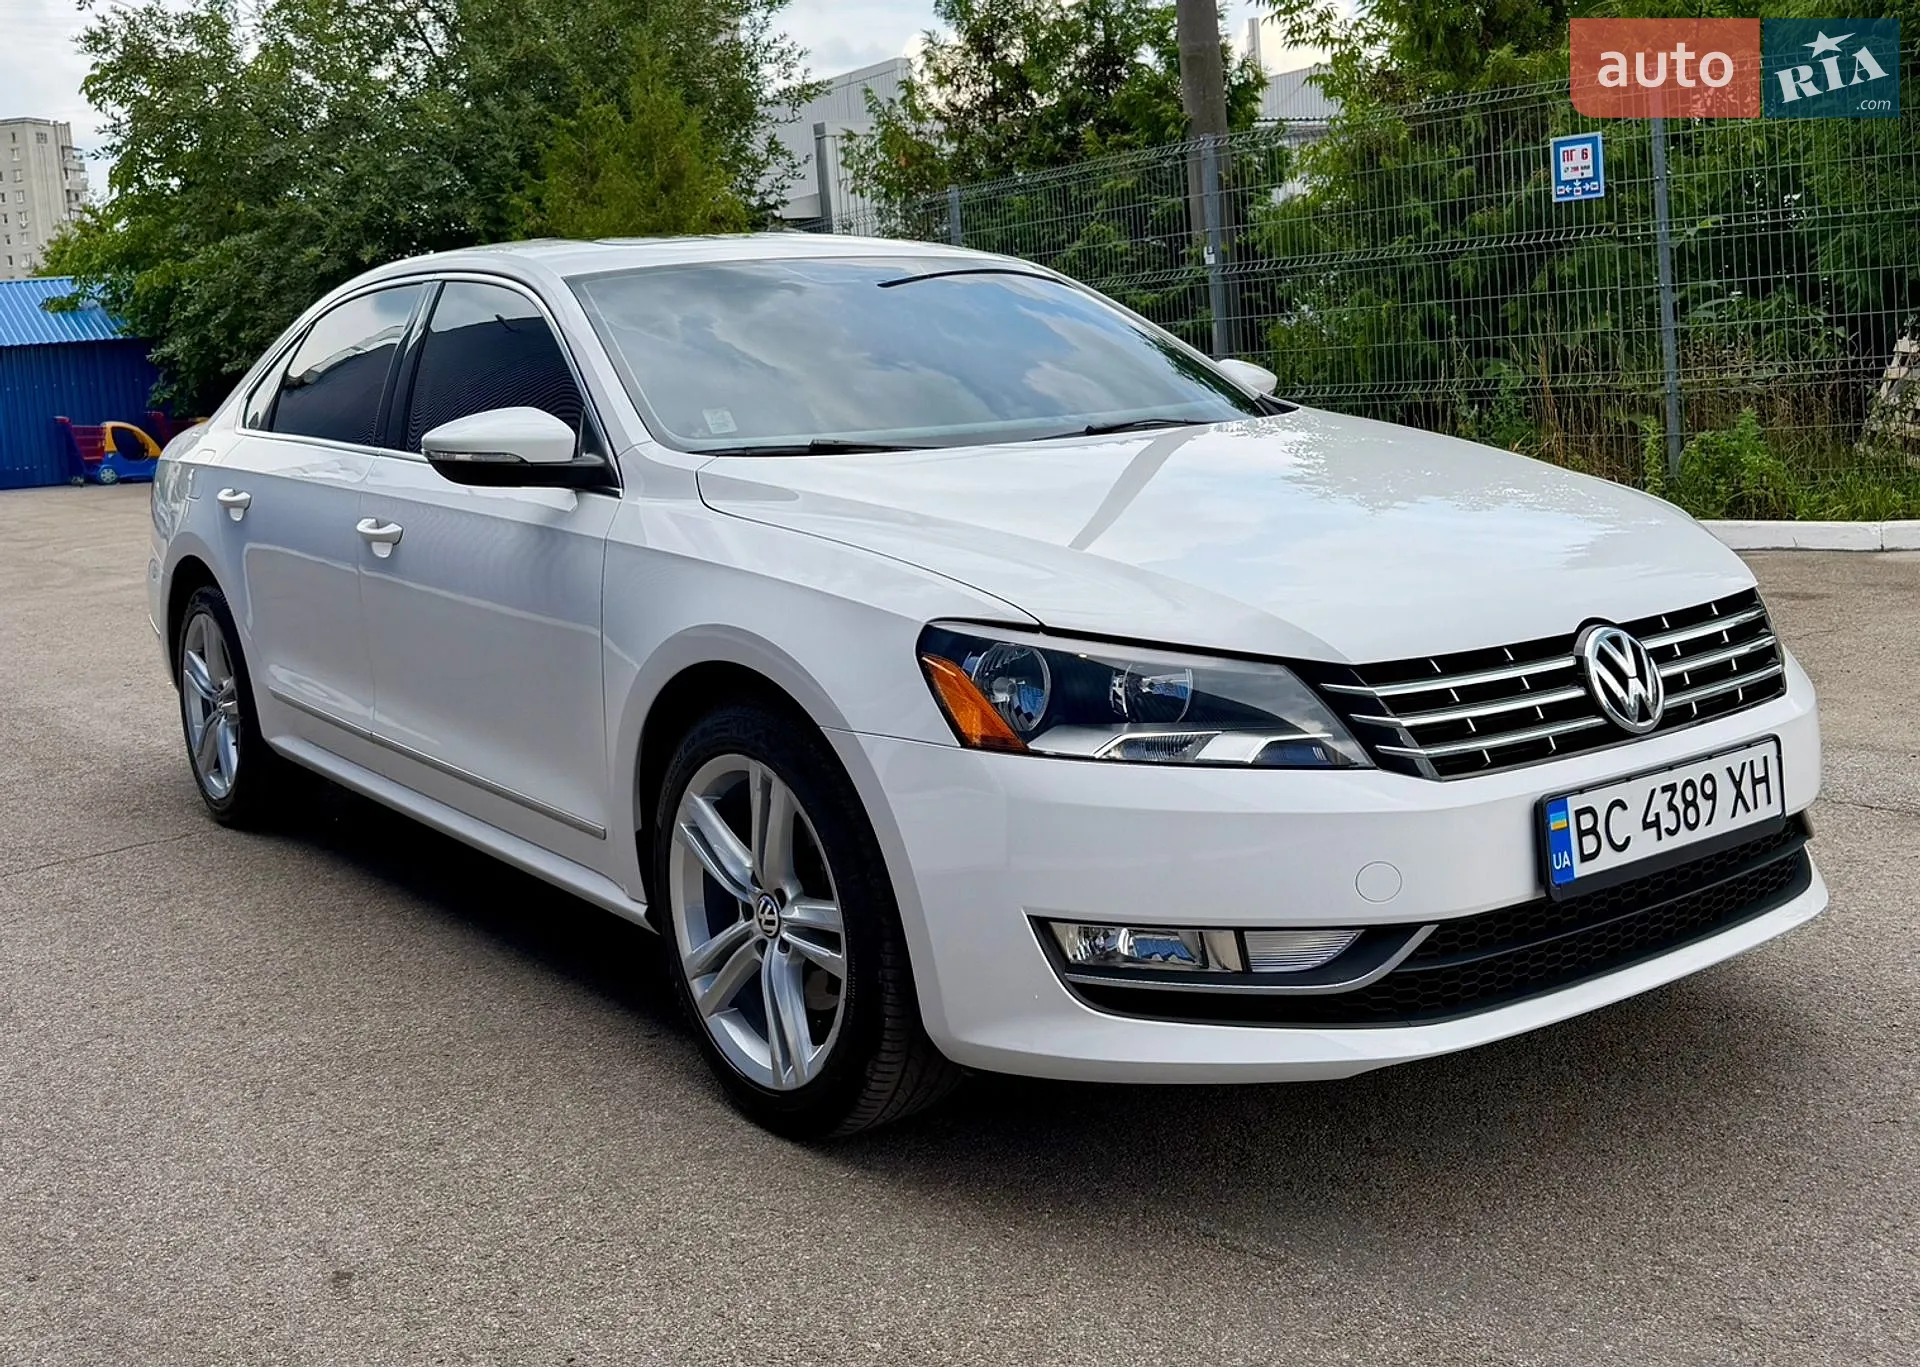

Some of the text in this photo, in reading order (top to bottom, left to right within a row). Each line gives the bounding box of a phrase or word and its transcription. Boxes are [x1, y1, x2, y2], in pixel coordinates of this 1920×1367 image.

[1562, 148, 1589, 162] ПГ 6
[1575, 755, 1772, 863] BC 4389 XH
[1553, 852, 1571, 871] UA
